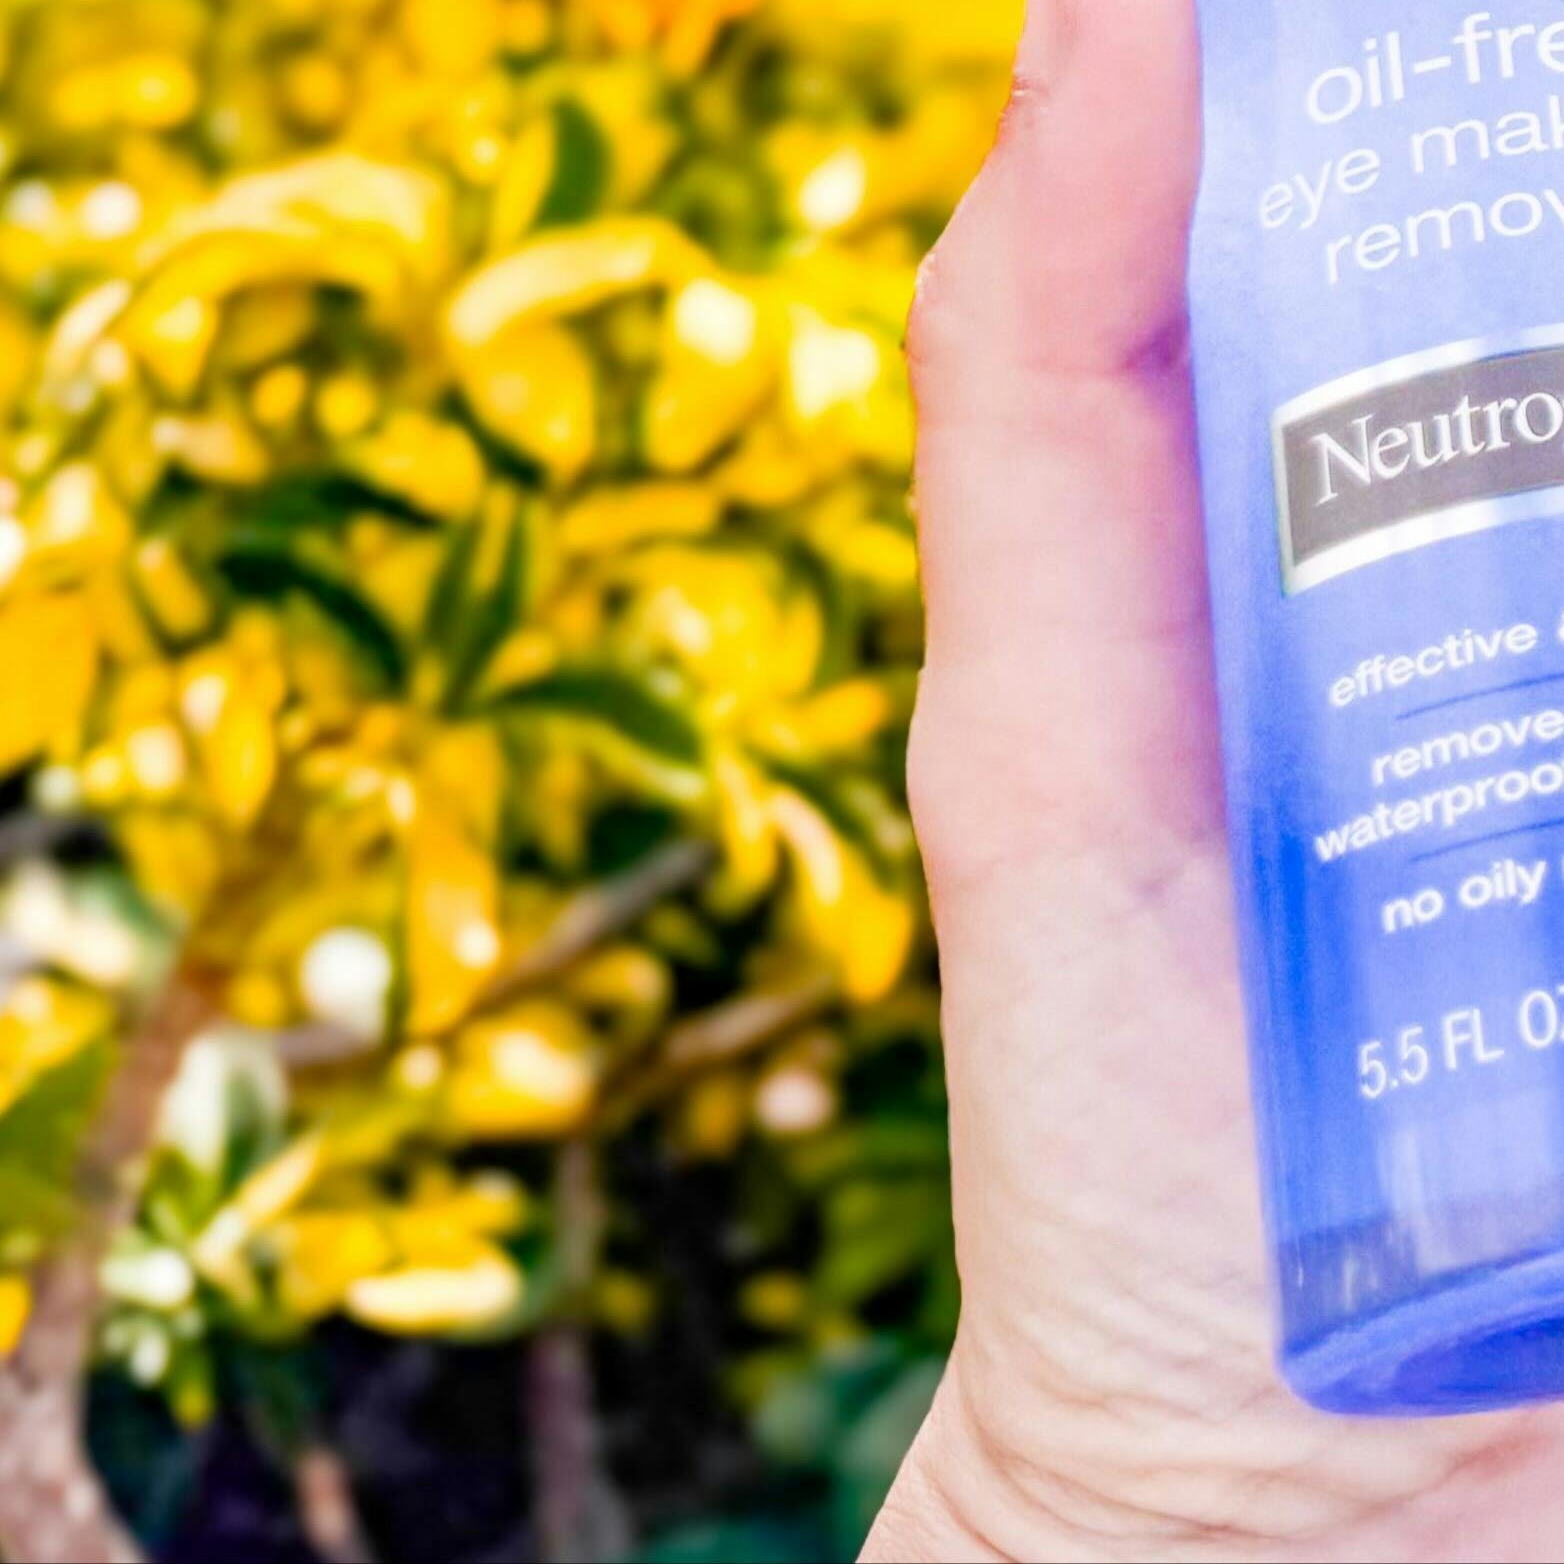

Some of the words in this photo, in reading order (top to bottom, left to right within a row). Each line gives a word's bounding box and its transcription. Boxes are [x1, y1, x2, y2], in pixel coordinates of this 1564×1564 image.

[1258, 146, 1381, 231] eye
[1328, 621, 1539, 707] effective
[1381, 885, 1444, 934] no
[1459, 858, 1547, 907] oily
[1357, 1026, 1429, 1100] 5.5
[1441, 1008, 1505, 1072] FL
